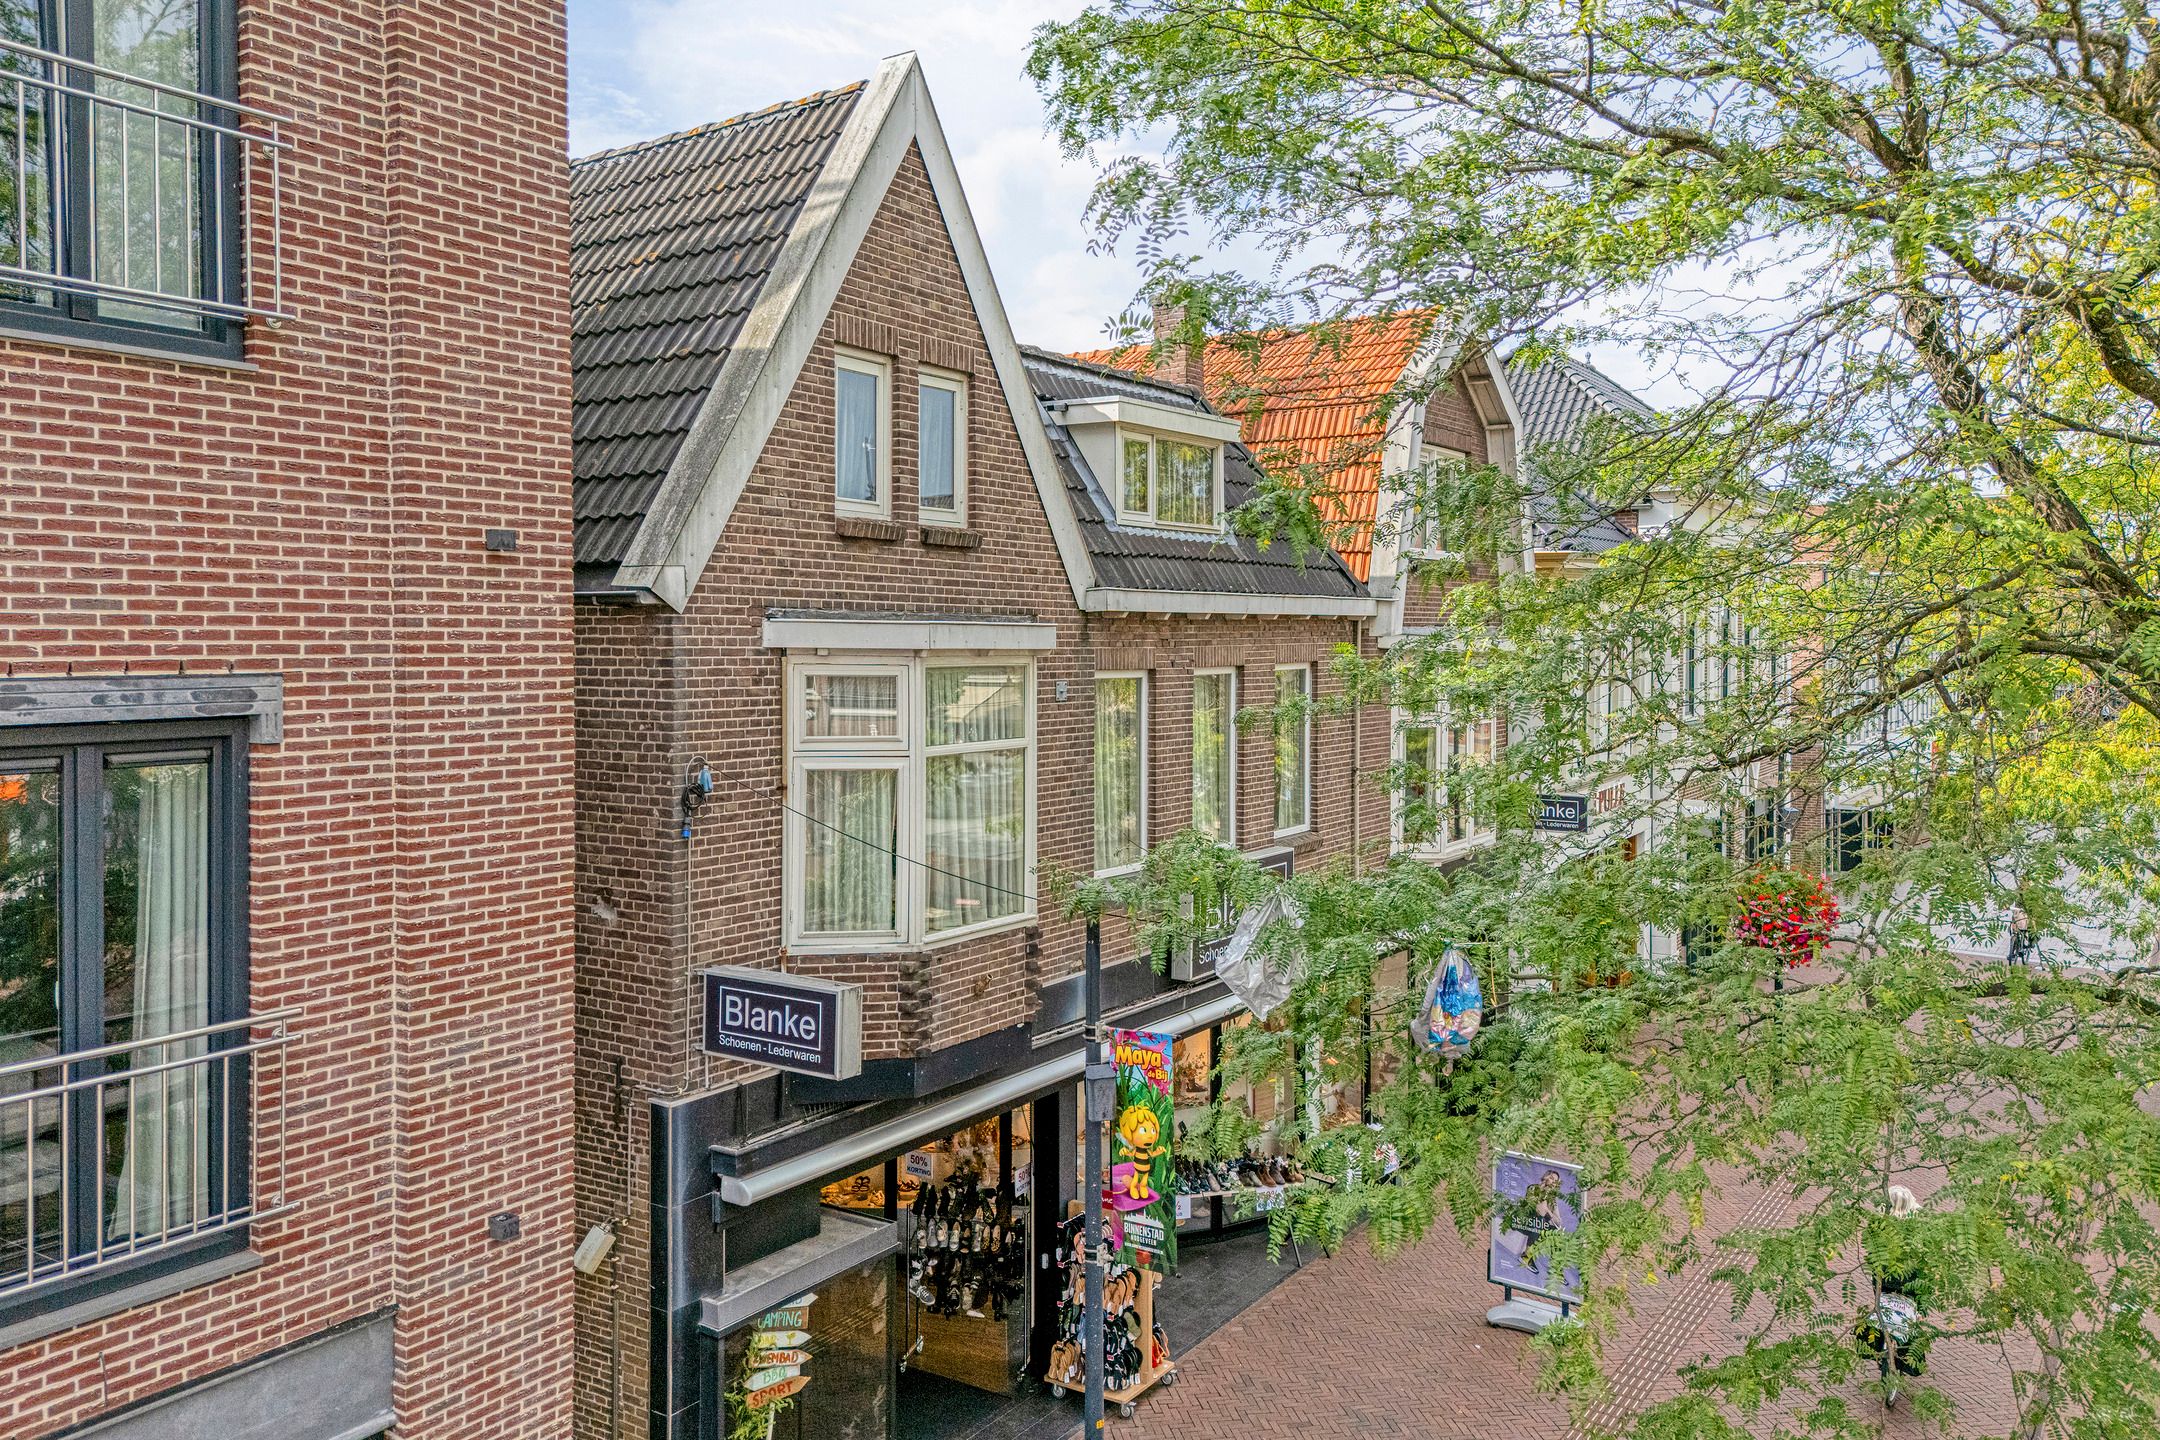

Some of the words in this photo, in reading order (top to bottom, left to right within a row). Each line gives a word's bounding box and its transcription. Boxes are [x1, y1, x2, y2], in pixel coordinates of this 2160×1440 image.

[1527, 803, 1576, 819] lanke
[1546, 821, 1579, 829] Lederwaren
[725, 995, 816, 1040] Blanke
[719, 1034, 761, 1052] Schoenen
[768, 1043, 821, 1063] Lederwaren
[1115, 1044, 1162, 1070] Maya
[1147, 1070, 1155, 1078] de
[1155, 1068, 1168, 1083] Bij
[910, 1154, 928, 1167] 50%
[907, 1165, 931, 1177] KORTING
[1124, 1222, 1164, 1240] BINNENSTAD
[758, 1311, 802, 1329] CAMPING
[763, 1366, 787, 1384] BBQ
[752, 1380, 793, 1406] SPORT
